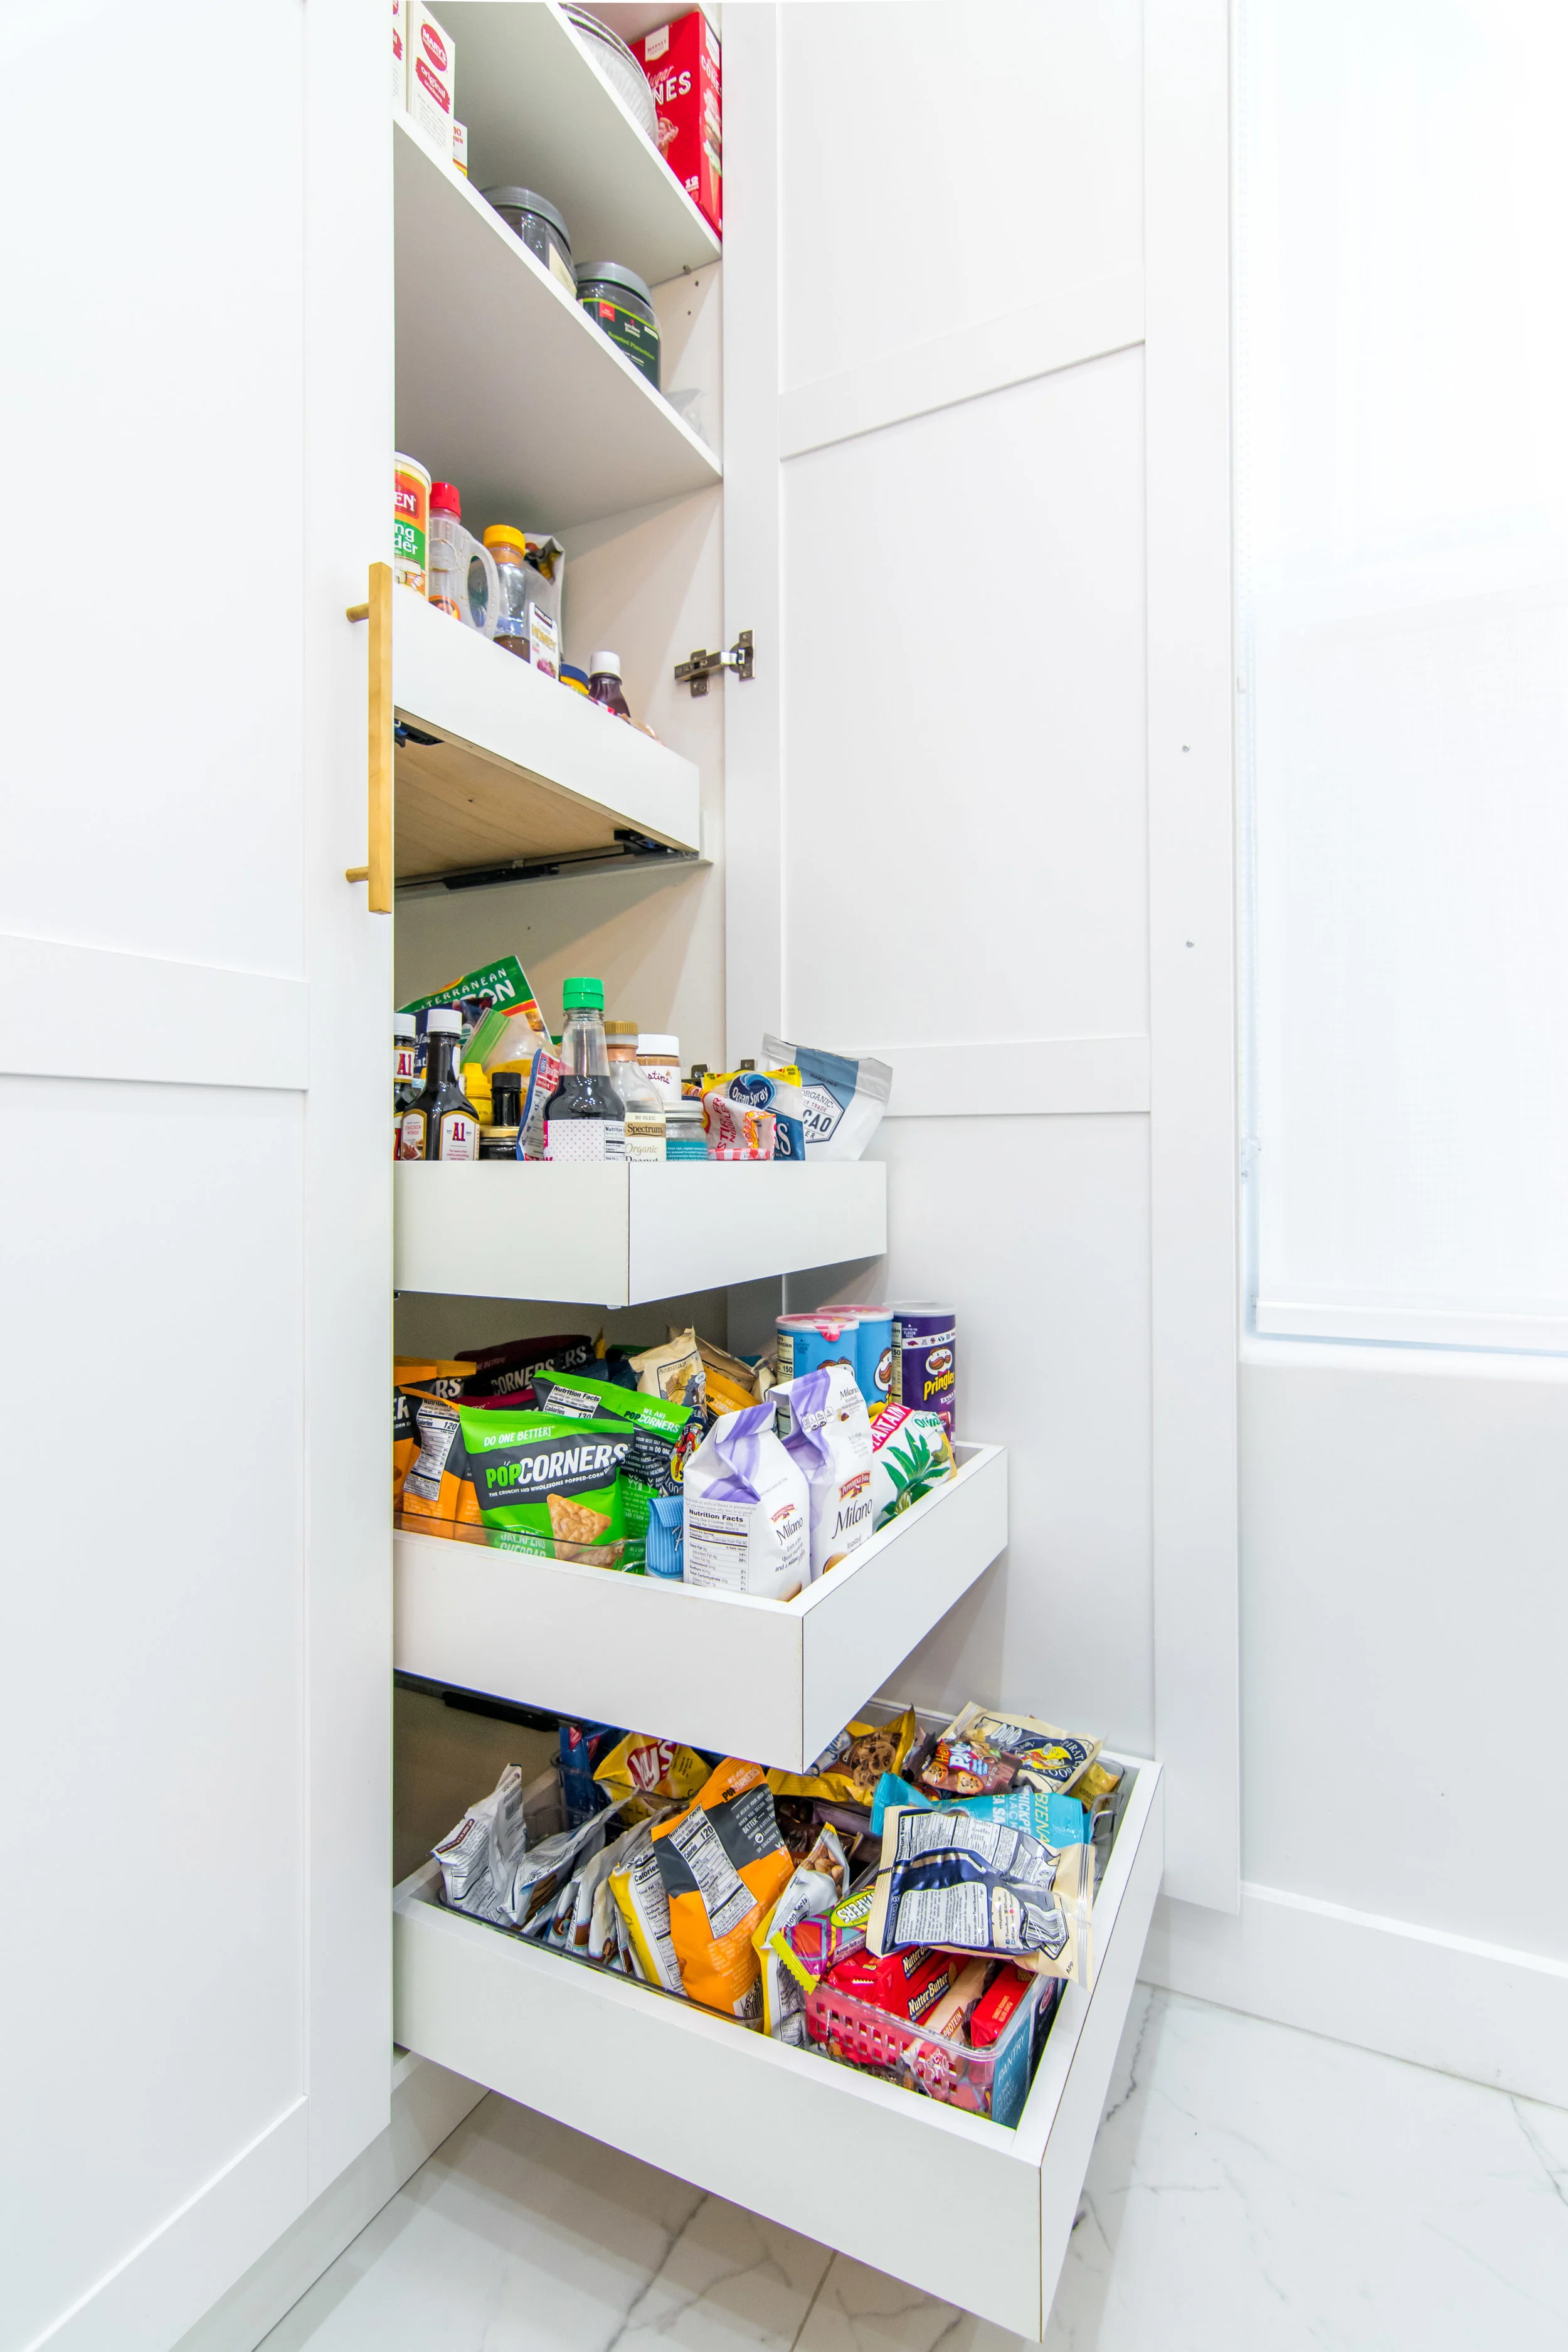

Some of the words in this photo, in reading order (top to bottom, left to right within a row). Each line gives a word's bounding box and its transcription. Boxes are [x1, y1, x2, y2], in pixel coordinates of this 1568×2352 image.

[421, 65, 446, 99] original
[701, 55, 721, 97] CONE
[652, 71, 691, 105] NES
[686, 175, 699, 189] 12
[608, 331, 630, 345] Roasted
[531, 623, 557, 653] HONEY
[732, 1086, 750, 1105] Ocean
[750, 1087, 769, 1107] Spray
[802, 1090, 832, 1108] ORGANIC
[712, 1098, 722, 1115] FR
[811, 1102, 827, 1113] TRADE
[720, 1102, 737, 1143] NOODLES
[803, 1109, 832, 1133] CAO
[717, 1116, 729, 1150] STIR
[625, 1143, 658, 1155] Organic
[553, 1385, 581, 1397] Nutrition
[582, 1394, 600, 1402] Facts
[923, 1369, 955, 1401] Pringles
[725, 1398, 735, 1406] ARE
[840, 1387, 859, 1401] Milano
[845, 1395, 857, 1403] toasted
[940, 1390, 954, 1404] EXTRA
[544, 1405, 566, 1415] Calories
[643, 1407, 653, 1416] WE
[841, 1399, 864, 1410] marshmallow
[444, 1421, 458, 1431] 120
[623, 1410, 681, 1433] POPCORNERS
[484, 1436, 496, 1447] DO
[499, 1433, 516, 1443] ONE
[517, 1427, 551, 1441] BETTER!
[485, 1443, 629, 1489] POPCORNERS
[530, 1480, 564, 1492] WHOLESOME
[564, 1471, 604, 1485] POPPED-CORN
[842, 1477, 862, 1495] PEPPERIDGE
[861, 1474, 869, 1483] FARM
[689, 1509, 720, 1520] Nutrition
[831, 1499, 872, 1539] Milano
[776, 1517, 803, 1546] Milano
[787, 1542, 795, 1552] Enjoy
[847, 1532, 862, 1549] toasted
[689, 1559, 708, 1568] Cholesterol
[775, 1563, 785, 1572] and
[788, 1557, 798, 1566] Milano
[781, 1552, 793, 1562] quiet
[697, 1572, 721, 1582] Carbohydrate
[721, 1766, 760, 1801] POPCORNERS
[727, 1775, 736, 1784] WE
[750, 1797, 758, 1806] YOUR
[756, 1790, 765, 1800] BEST
[1078, 1787, 1094, 1801] DOUGH
[738, 1816, 748, 1826] WHEN
[754, 1801, 766, 1813] DECIDE
[993, 1807, 1006, 1823] SA
[1019, 1793, 1031, 1835] HICKPE
[1036, 1793, 1051, 1843] BIENA
[742, 1817, 758, 1834] BETTER
[747, 1825, 761, 1840] RUNNING
[762, 1816, 771, 1826] LITTLE
[762, 1821, 777, 1837] LAUGHING
[684, 1844, 698, 1861] Calories
[699, 1825, 714, 1841] 120
[761, 1833, 776, 1848] SNACKING
[634, 1863, 659, 1882] Calories
[638, 1887, 648, 1895] Total
[644, 1897, 665, 1910] Cholesterol
[646, 1905, 660, 1916] Sodium
[793, 1896, 808, 1912] Facts
[649, 1912, 658, 1920] Total
[654, 1926, 667, 1936] Protein
[849, 1941, 857, 1949] Facts
[903, 1949, 921, 1973] Nutter
[909, 1966, 918, 1976] PEANUT
[908, 1989, 930, 2016] Nutter
[928, 1973, 948, 1999] Butter
[916, 2007, 926, 2017] PEANUT
[925, 1998, 935, 2009] BUTTER
[943, 2011, 963, 2037] PROTEIN
[998, 2034, 1025, 2085] PANTRY
